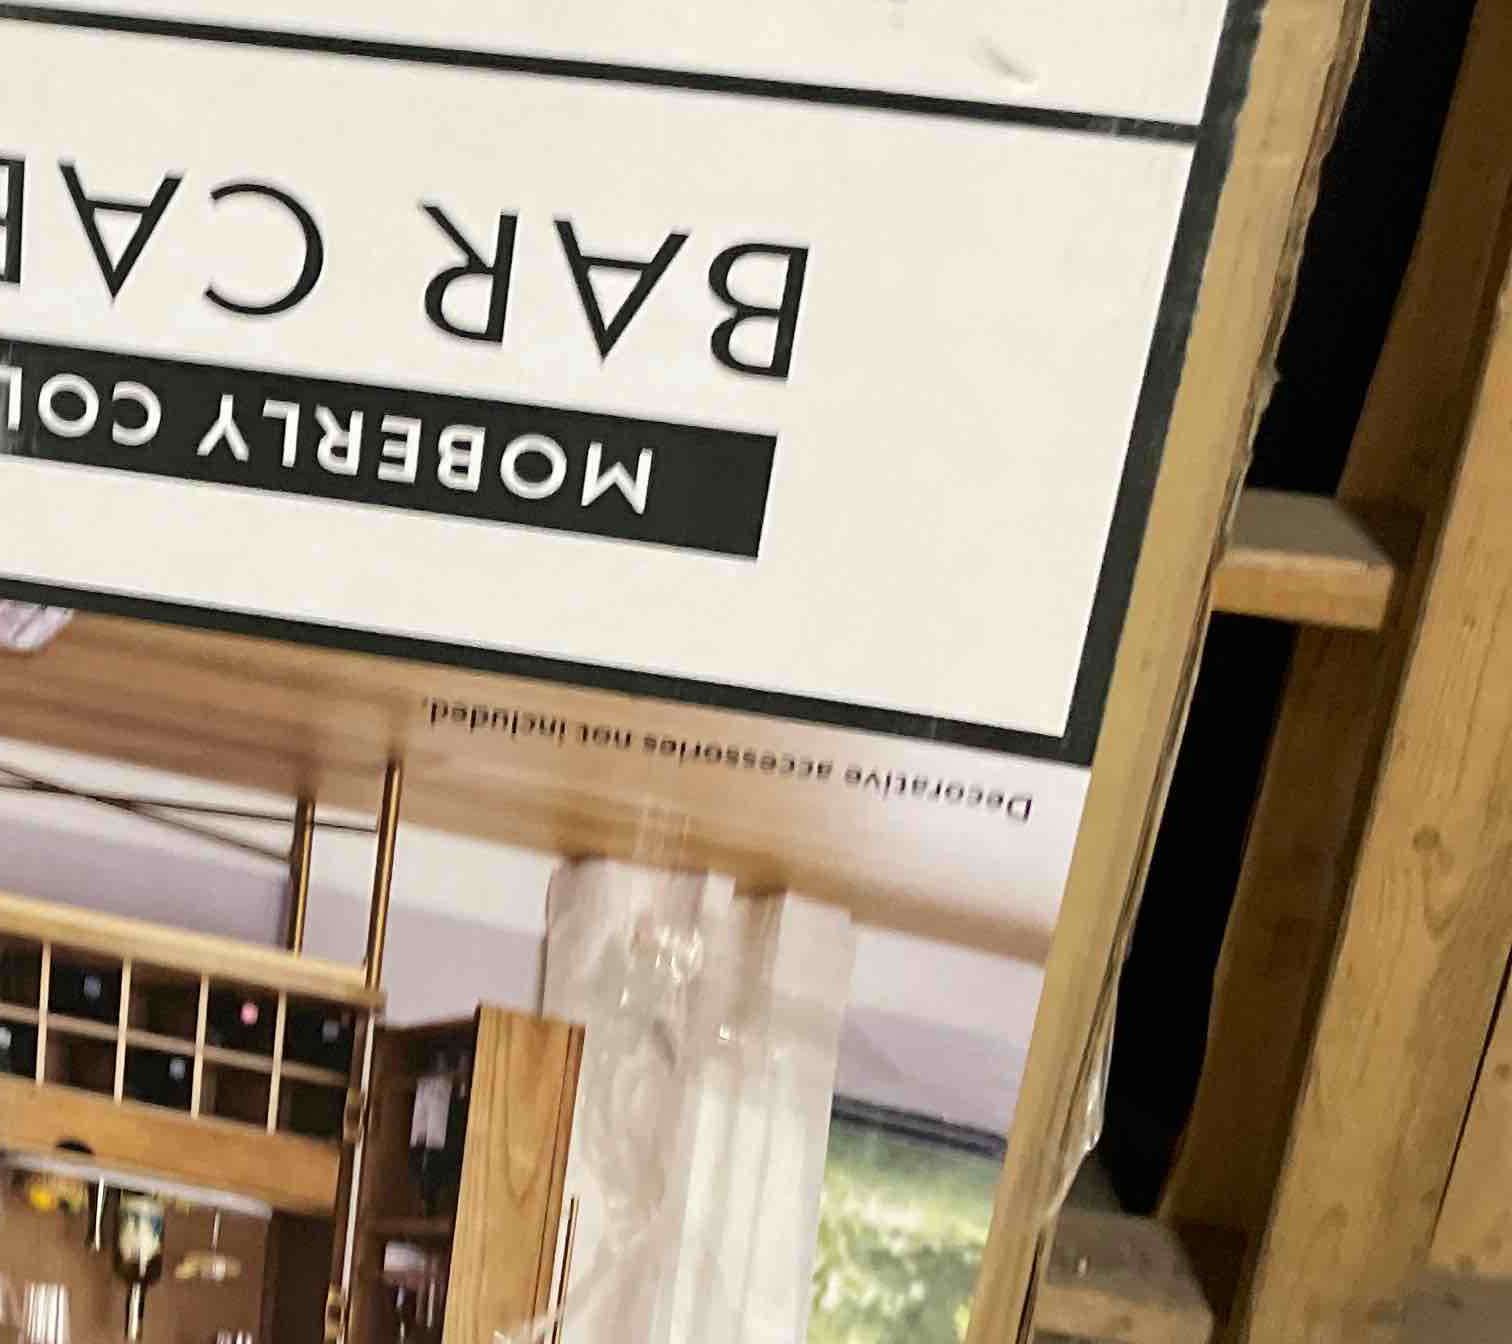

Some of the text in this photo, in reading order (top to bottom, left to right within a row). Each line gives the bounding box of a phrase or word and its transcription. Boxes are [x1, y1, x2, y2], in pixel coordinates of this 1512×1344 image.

[418, 203, 812, 382] BAR
[195, 391, 654, 516] MOBERLY
[421, 697, 1034, 824] Decorative accessories not included.
